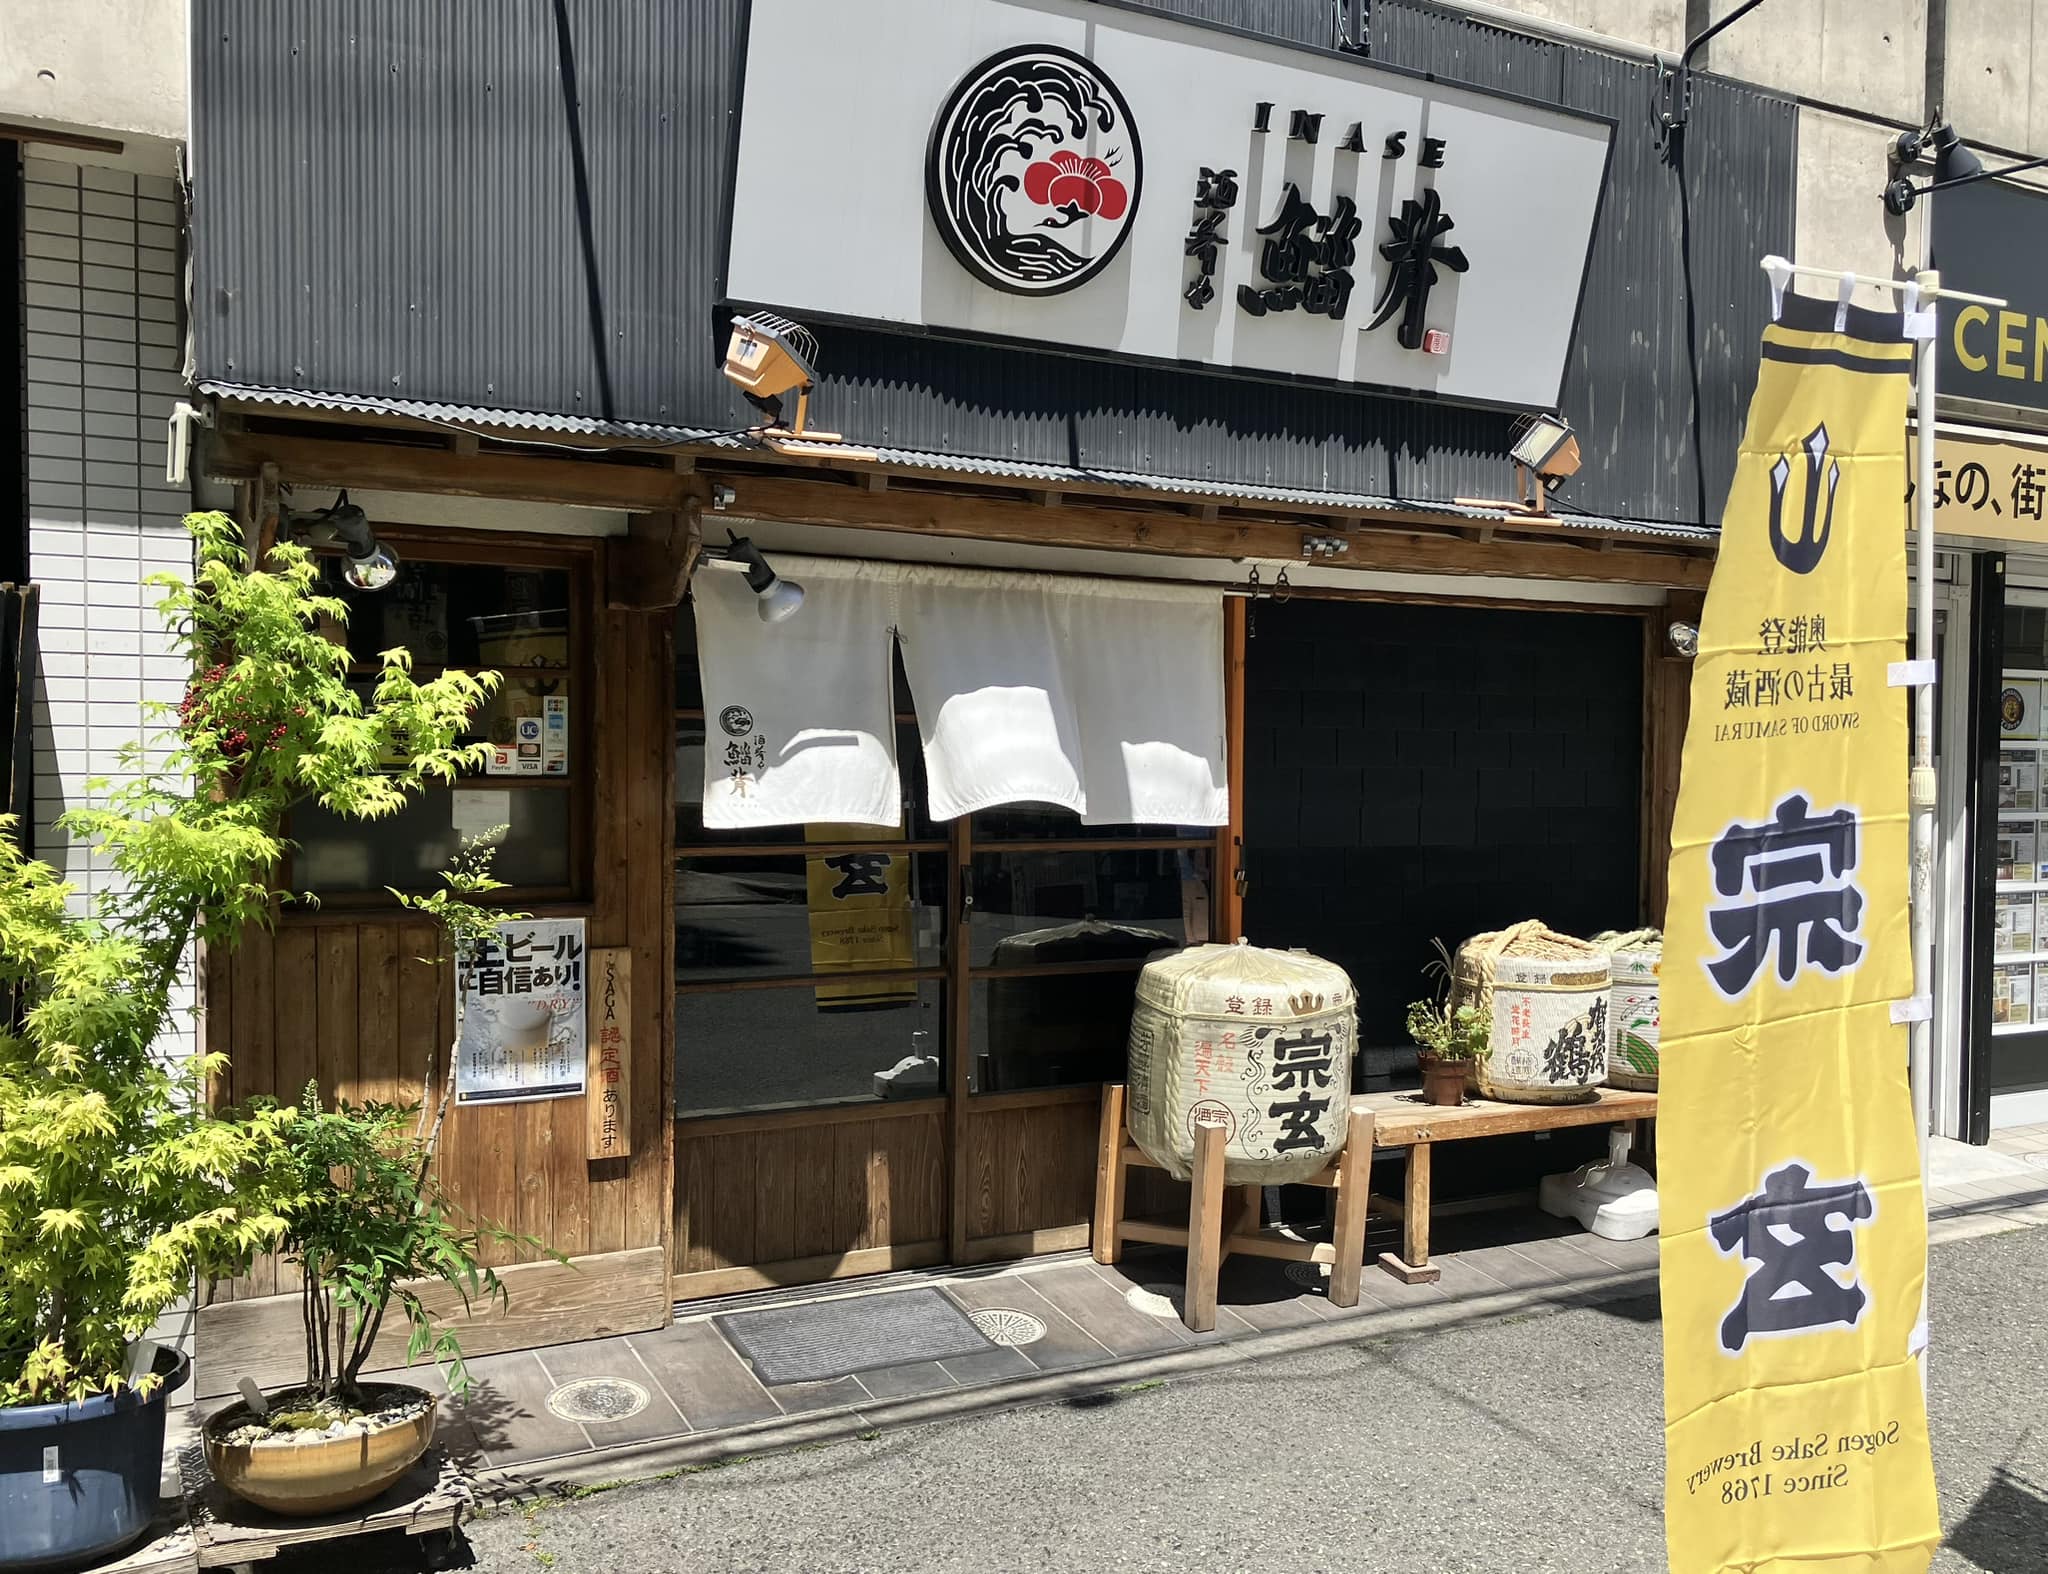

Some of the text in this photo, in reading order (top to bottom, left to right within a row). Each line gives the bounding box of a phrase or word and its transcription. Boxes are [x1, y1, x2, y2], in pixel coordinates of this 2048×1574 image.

[1251, 102, 1447, 168] INASE
[521, 726, 539, 736] UC
[604, 968, 616, 1021] SAGA
[1224, 996, 1273, 1016] 登録
[1268, 1028, 1333, 1153] 宗玄
